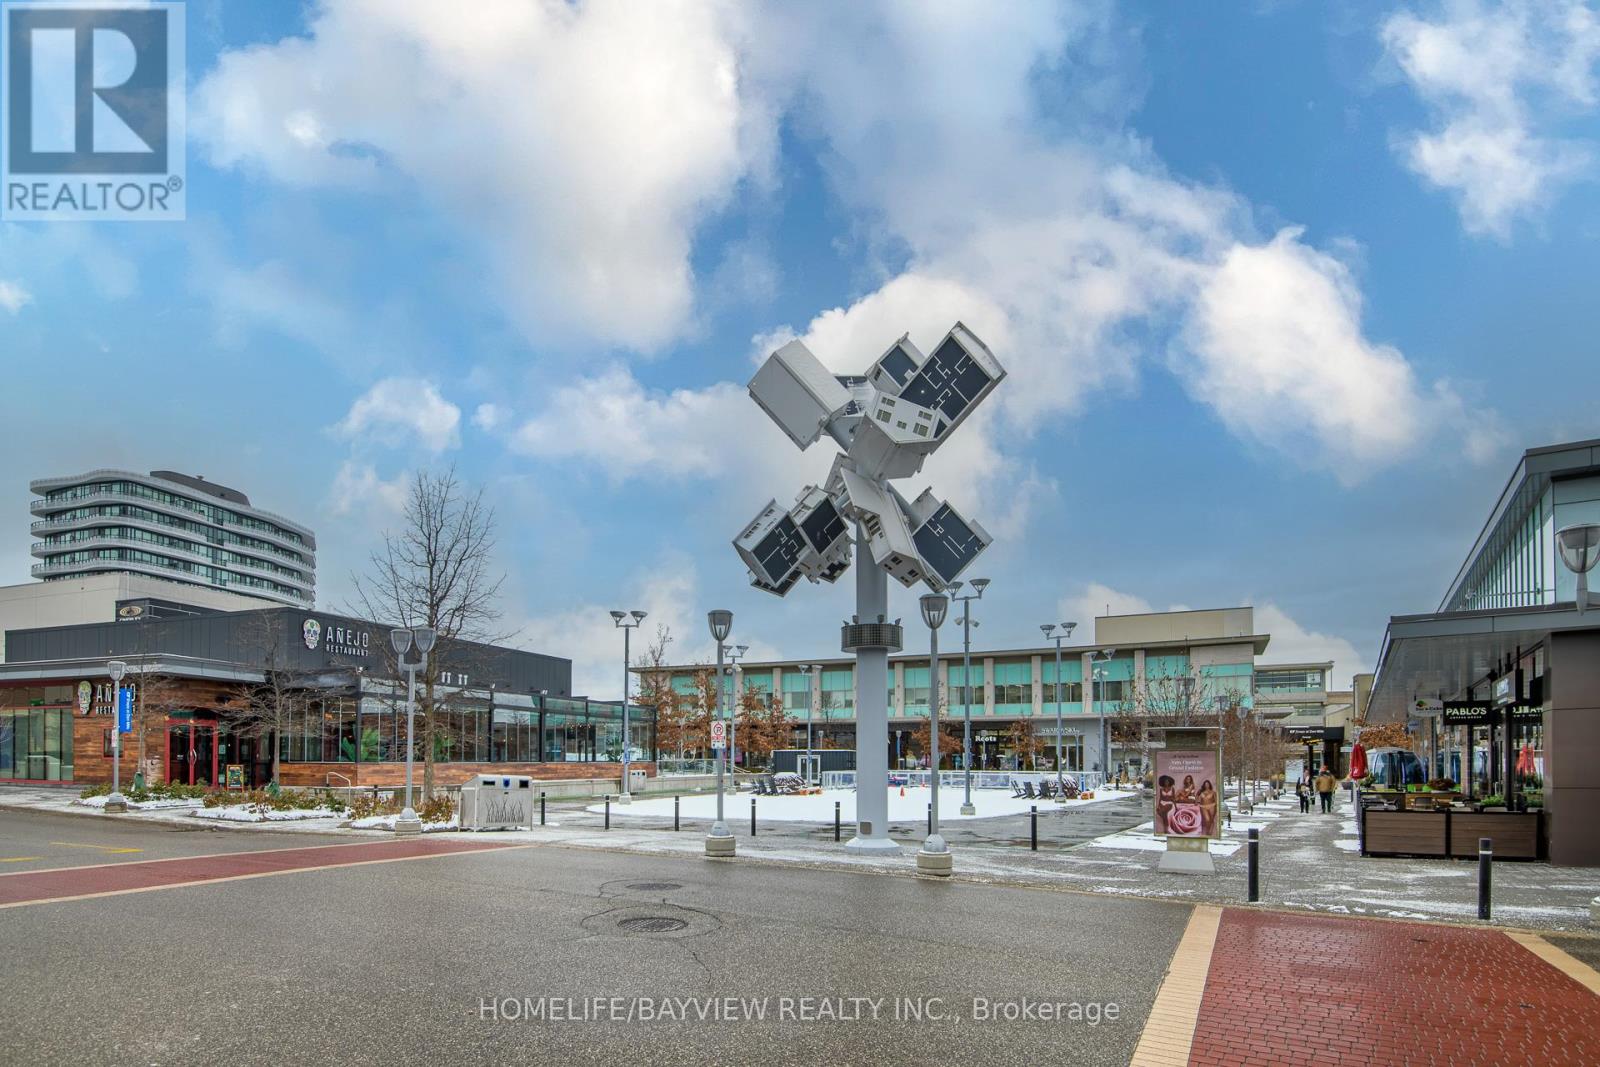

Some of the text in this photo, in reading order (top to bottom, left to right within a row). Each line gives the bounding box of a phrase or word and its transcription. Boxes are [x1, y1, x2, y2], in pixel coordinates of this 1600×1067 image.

[326, 626, 369, 648] AÑEJO
[326, 643, 369, 657] RESTAURANT
[1446, 707, 1487, 716] PABLO'S
